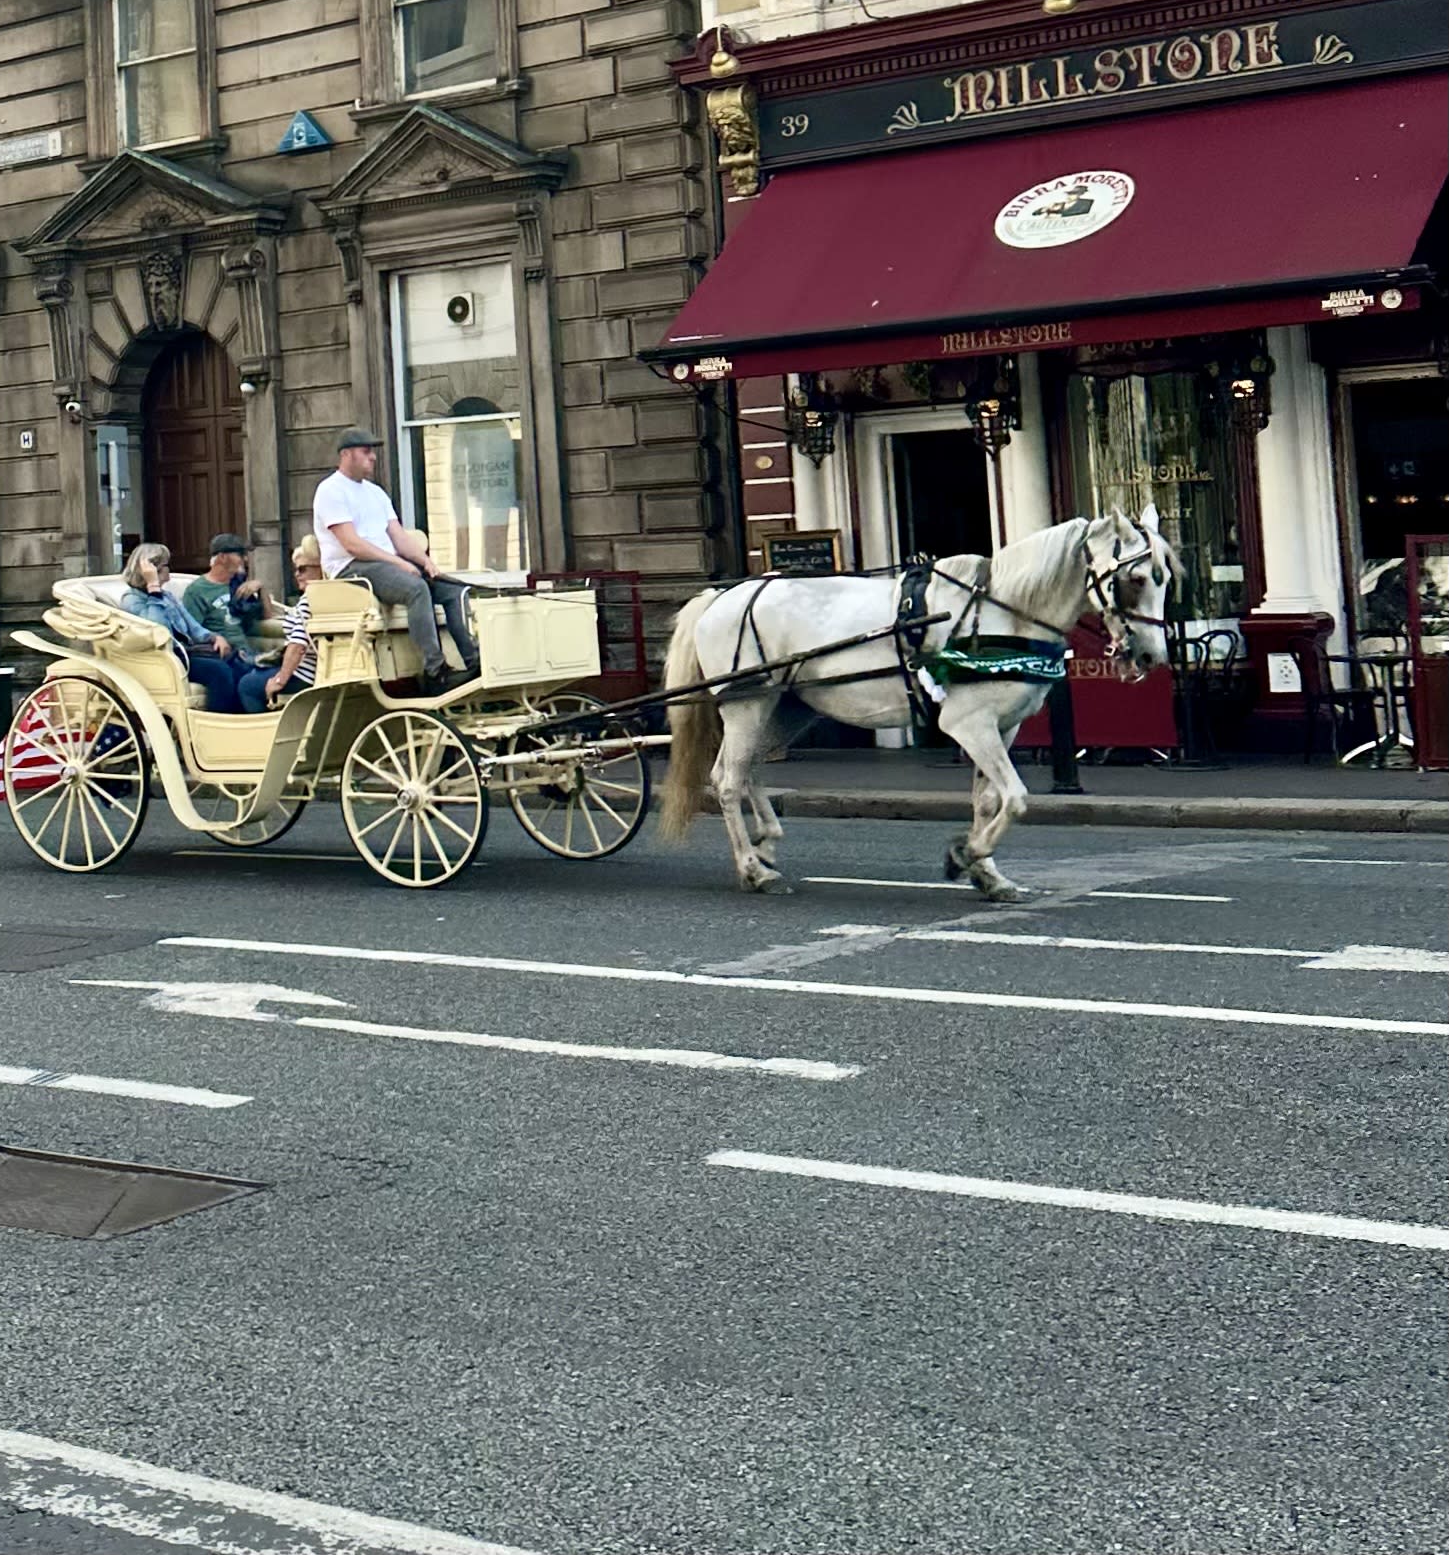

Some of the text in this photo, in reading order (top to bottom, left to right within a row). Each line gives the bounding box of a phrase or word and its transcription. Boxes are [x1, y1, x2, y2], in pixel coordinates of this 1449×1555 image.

[943, 21, 1283, 122] MILLSTONE
[781, 114, 809, 137] 39
[1004, 180, 1067, 218] BIRRA
[940, 322, 1072, 355] MILLSTONE
